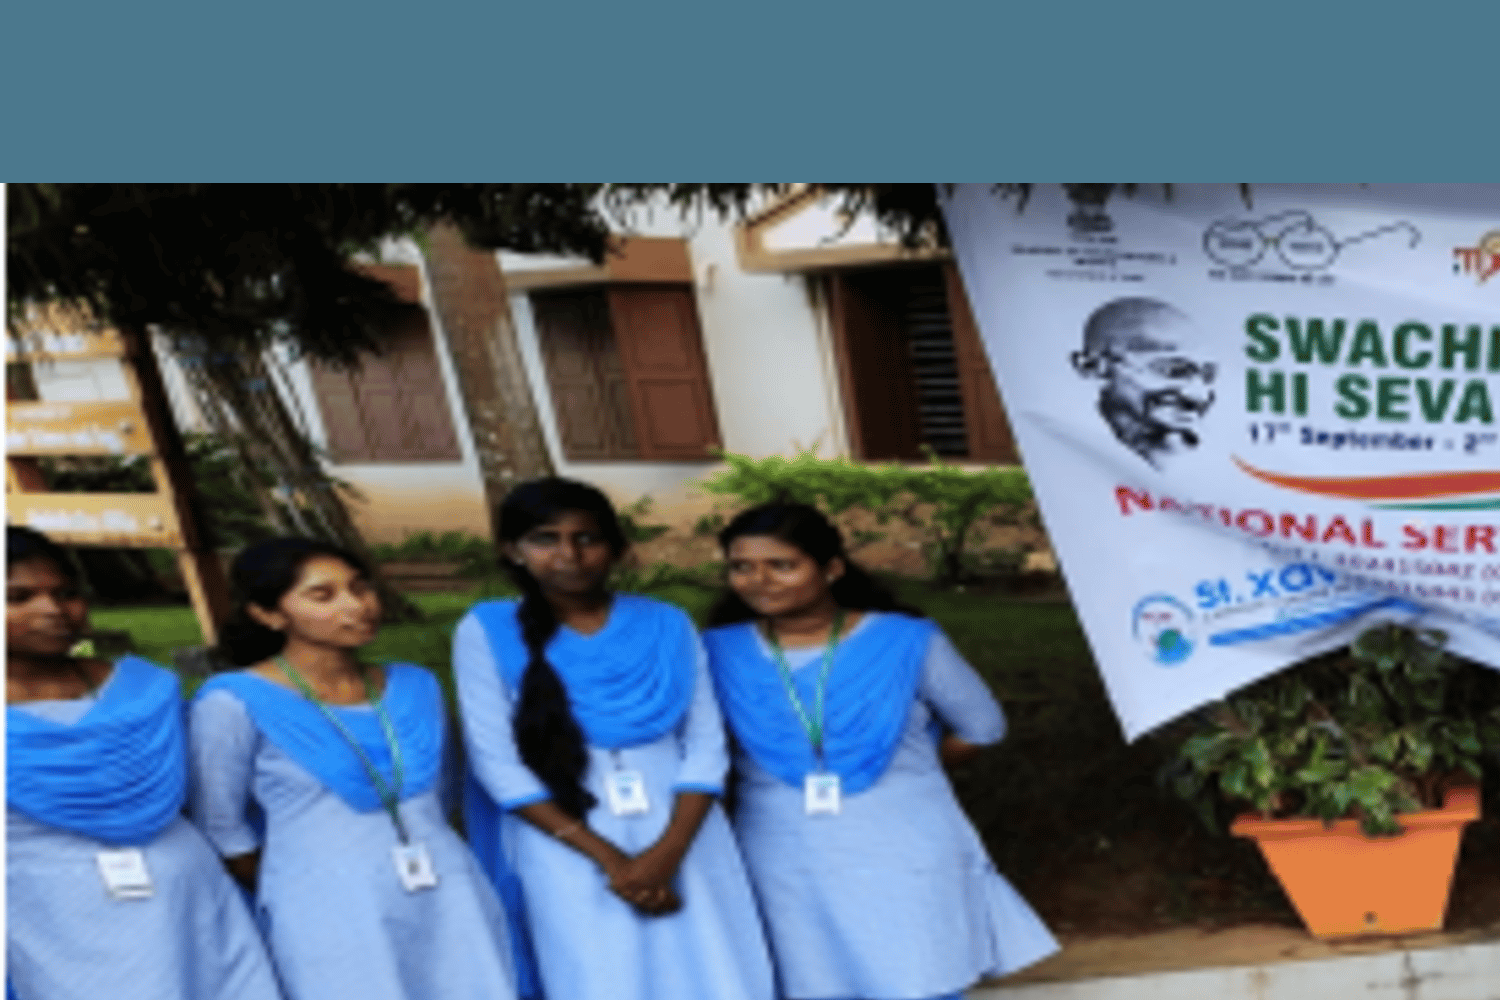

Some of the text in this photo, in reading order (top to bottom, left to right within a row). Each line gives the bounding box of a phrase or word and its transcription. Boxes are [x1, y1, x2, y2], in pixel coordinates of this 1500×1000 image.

[1244, 367, 1309, 417] HI
[1333, 374, 1495, 426] SEVA
[1300, 426, 1435, 452] September
